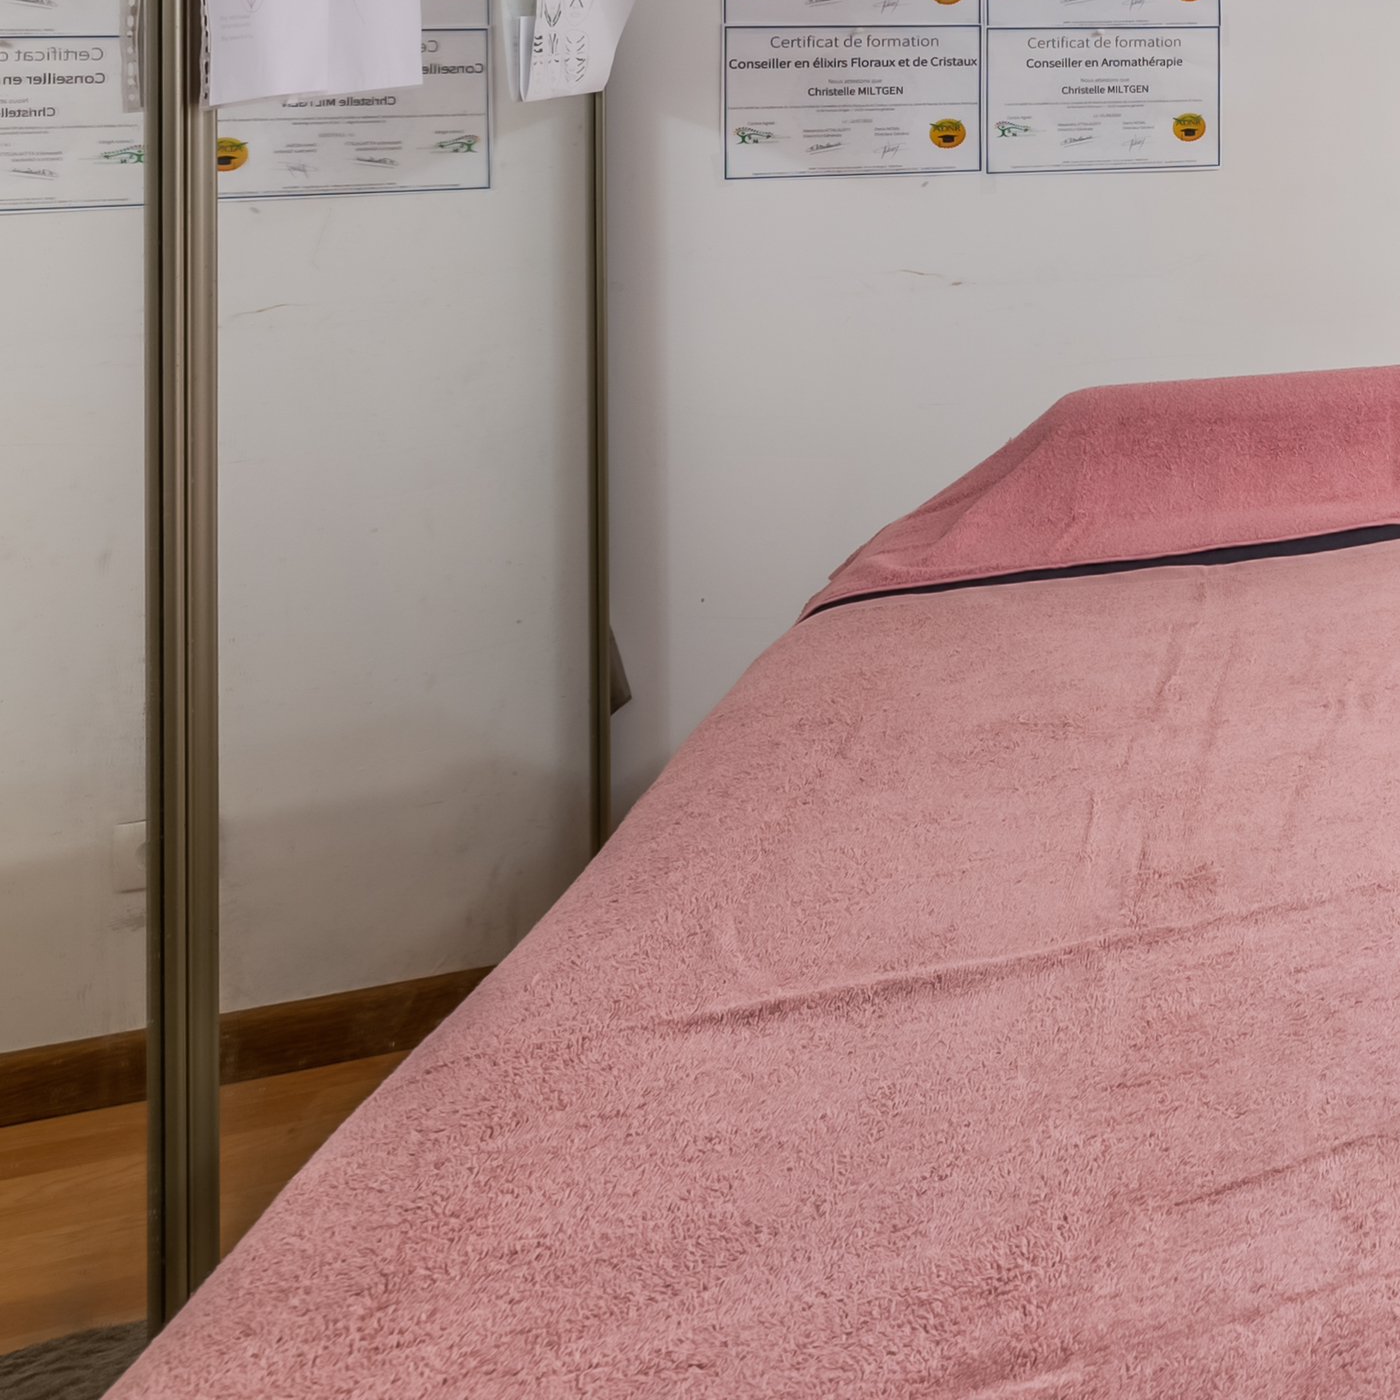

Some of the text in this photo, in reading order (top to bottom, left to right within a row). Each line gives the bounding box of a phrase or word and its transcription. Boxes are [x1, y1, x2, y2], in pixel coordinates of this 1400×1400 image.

[770, 35, 939, 49] Certificat de formation
[1028, 36, 1181, 49] Certificat de formation
[729, 55, 977, 69] Conseiller en élixirs Floraux et de Cristaux
[1026, 57, 1082, 68] Conseiller
[1101, 57, 1182, 69] Aromathérapie
[808, 86, 903, 96] Christelle MILTGEN
[1062, 85, 1149, 94] Christelle MILTGEN
